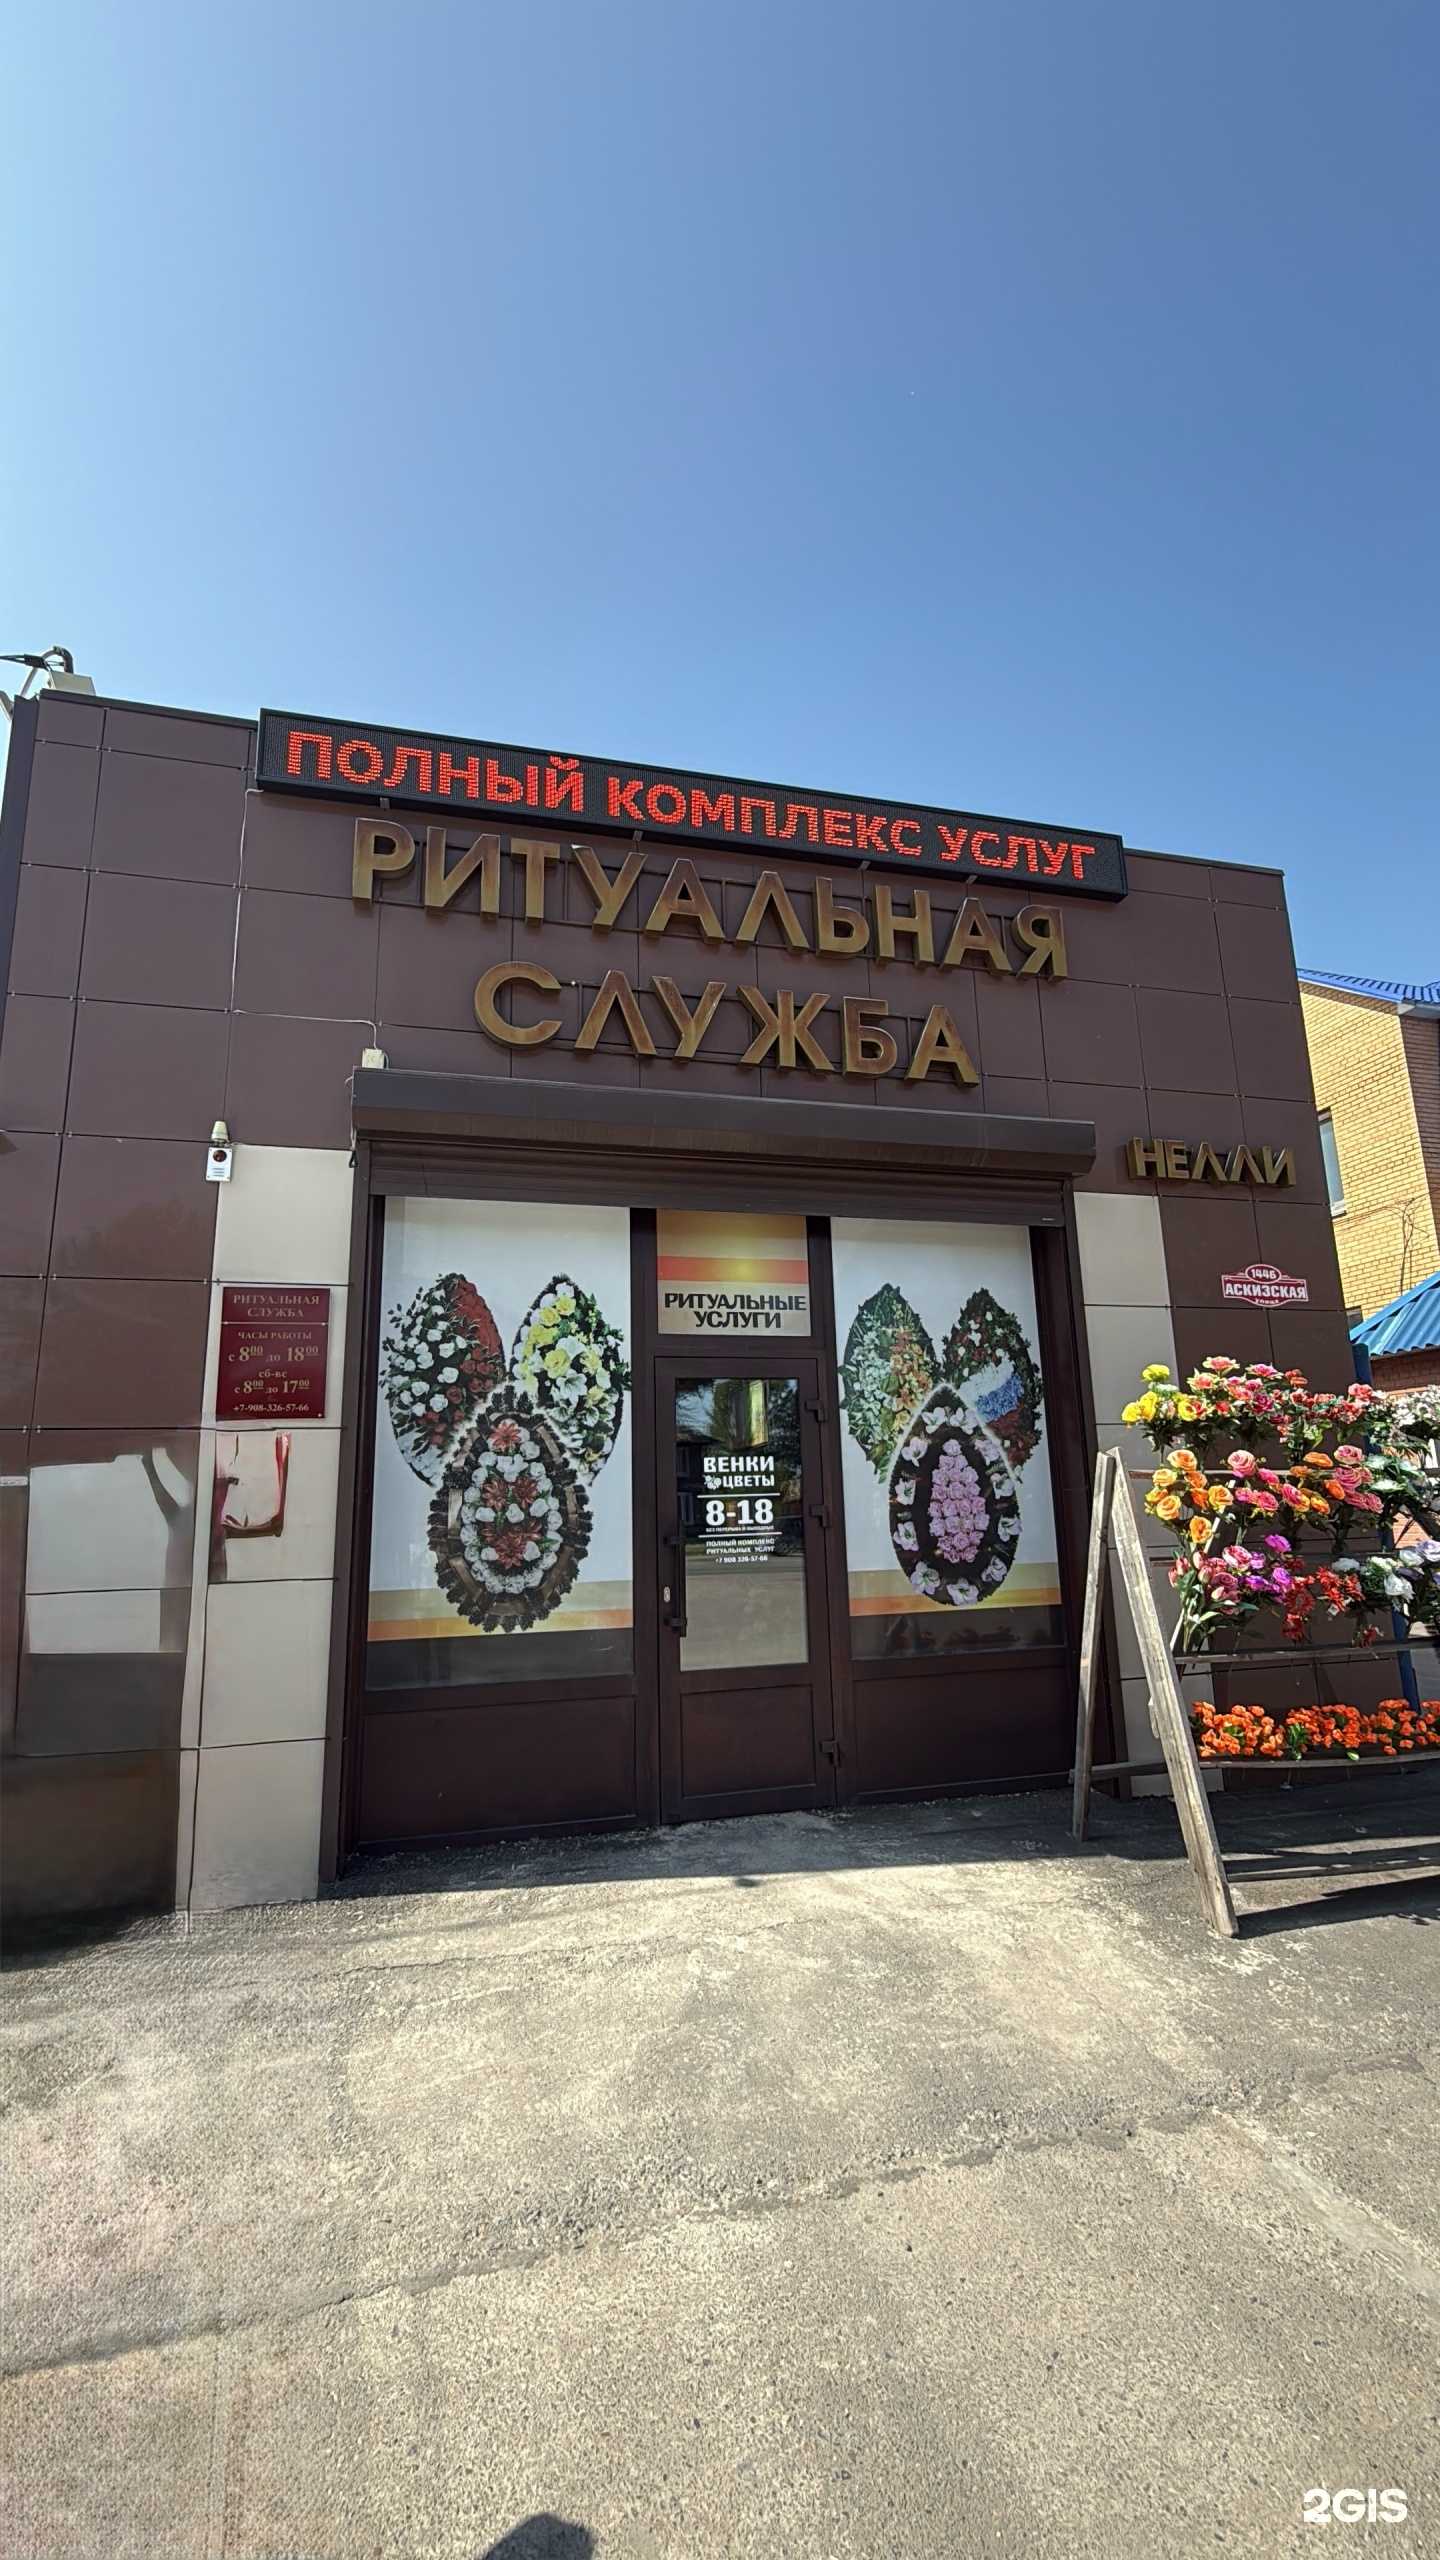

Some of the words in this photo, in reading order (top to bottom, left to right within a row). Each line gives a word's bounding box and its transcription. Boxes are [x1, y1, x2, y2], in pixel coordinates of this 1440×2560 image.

[288, 731, 585, 813] ПОЛНЫЙ
[607, 776, 922, 857] КОМПЛЕКС
[937, 824, 1097, 881] УСЛУГ
[352, 817, 1069, 981] РИТУАЛЬНАЯ
[473, 960, 981, 1088] СЛУЖБА
[1127, 1136, 1296, 1187] НЕЛЛИ
[1225, 1283, 1306, 1298] АСКИЗСКАЯ
[233, 1294, 320, 1305] РИТУАЛЬНАЯ
[664, 1292, 807, 1311] РИТУАЛЬНЫЕ
[247, 1307, 304, 1318] СЛУЖБА
[693, 1310, 782, 1328] УСЛУГИ
[238, 1331, 268, 1340] ЧАСЫ
[271, 1331, 312, 1340] РАБОТЫ
[265, 1353, 281, 1362] до
[258, 1369, 288, 1378] сб-вс
[265, 1386, 279, 1394] до
[703, 1456, 775, 1473] ВЕНКИ
[723, 1474, 775, 1488] ЦВЕТЫ
[705, 1498, 774, 1526] 8-18
[706, 1539, 737, 1547] ПОЛНЫЙ
[706, 1547, 751, 1555] РИТУАЛЬНЫХ
[754, 1545, 775, 1553] УСЛУГ
